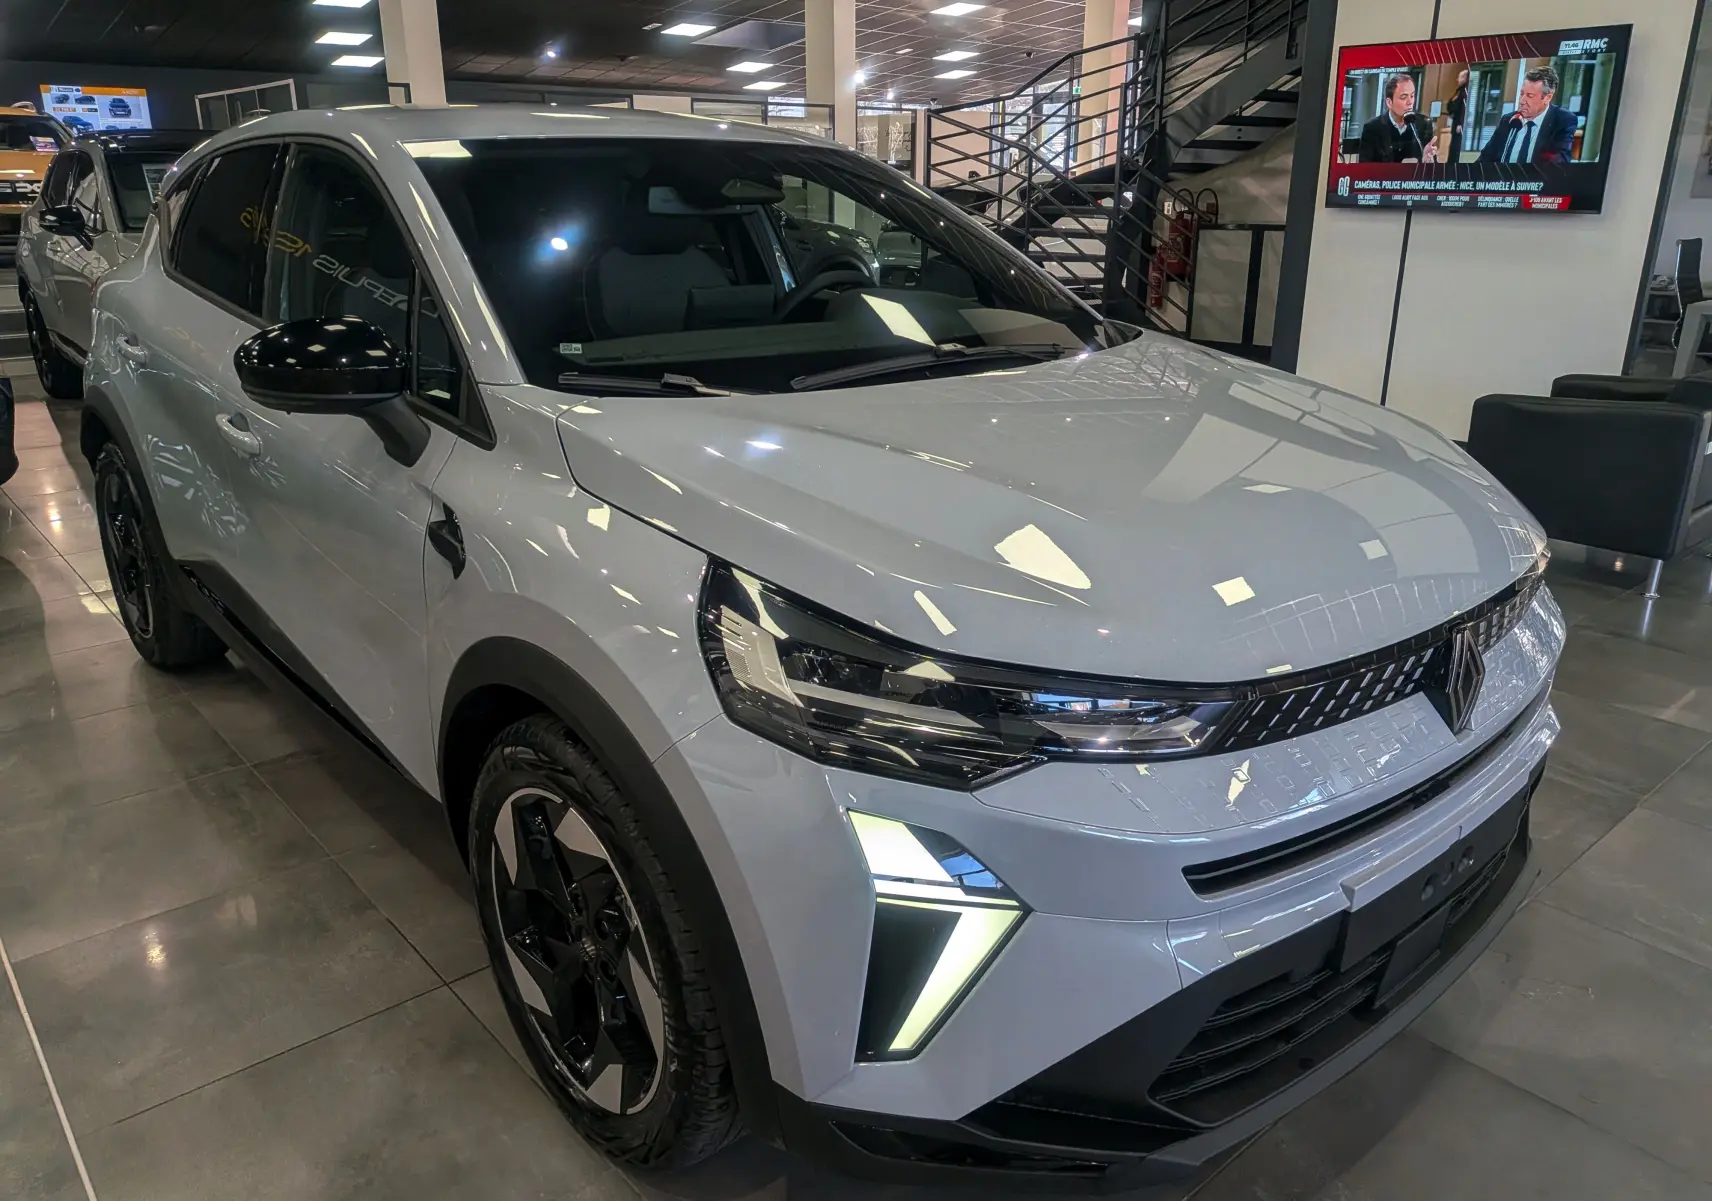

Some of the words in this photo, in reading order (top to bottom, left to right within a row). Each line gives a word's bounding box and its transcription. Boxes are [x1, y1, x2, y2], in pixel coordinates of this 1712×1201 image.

[1583, 37, 1609, 49] RMC
[1354, 179, 1381, 190] CAMÉRAS,
[1382, 180, 1401, 189] POLICE
[1402, 181, 1435, 190] MUNICIPALE
[1436, 180, 1456, 190] ARMÉE
[1460, 181, 1475, 191] NICE,
[1476, 182, 1485, 190] UN
[1486, 181, 1510, 191] MODÈLE
[1510, 180, 1516, 191] À
[1516, 182, 1544, 191] SUIVRE?
